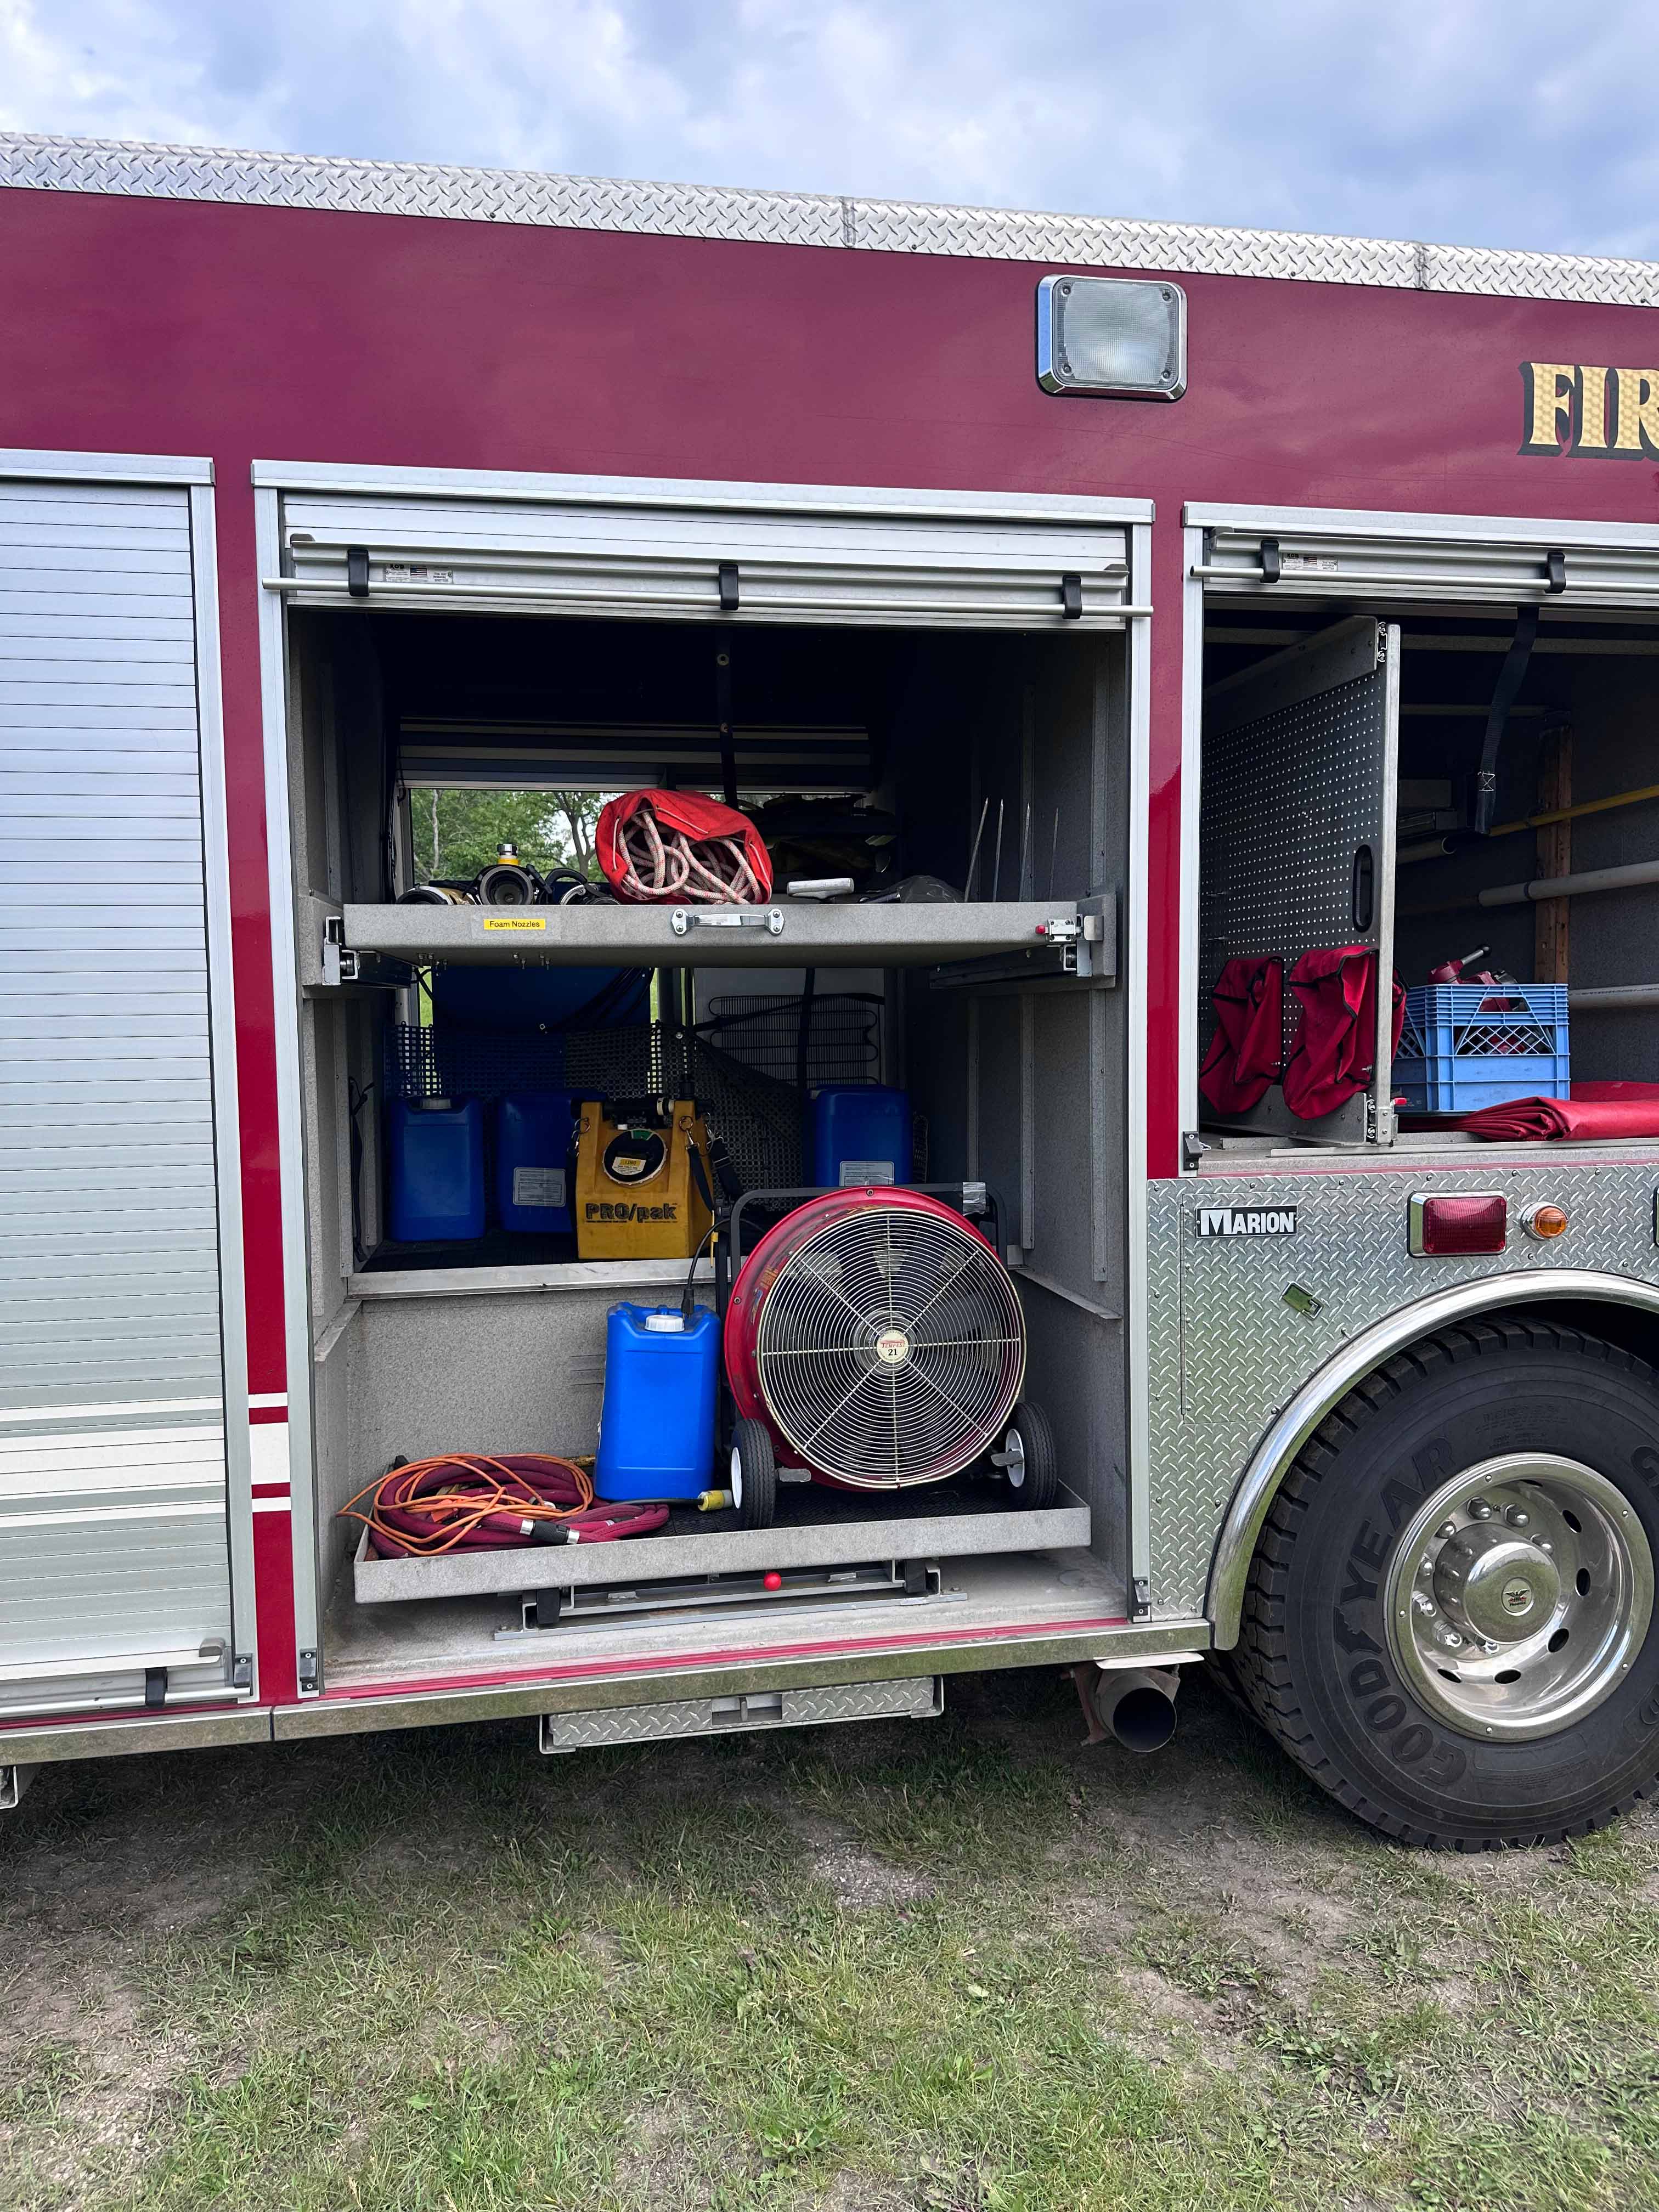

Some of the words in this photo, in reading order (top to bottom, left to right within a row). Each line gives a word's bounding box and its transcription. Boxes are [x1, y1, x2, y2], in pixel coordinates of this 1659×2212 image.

[1517, 361, 1659, 460] FIR
[585, 1203, 677, 1223] PRO/pak
[1200, 1209, 1294, 1235] MARION
